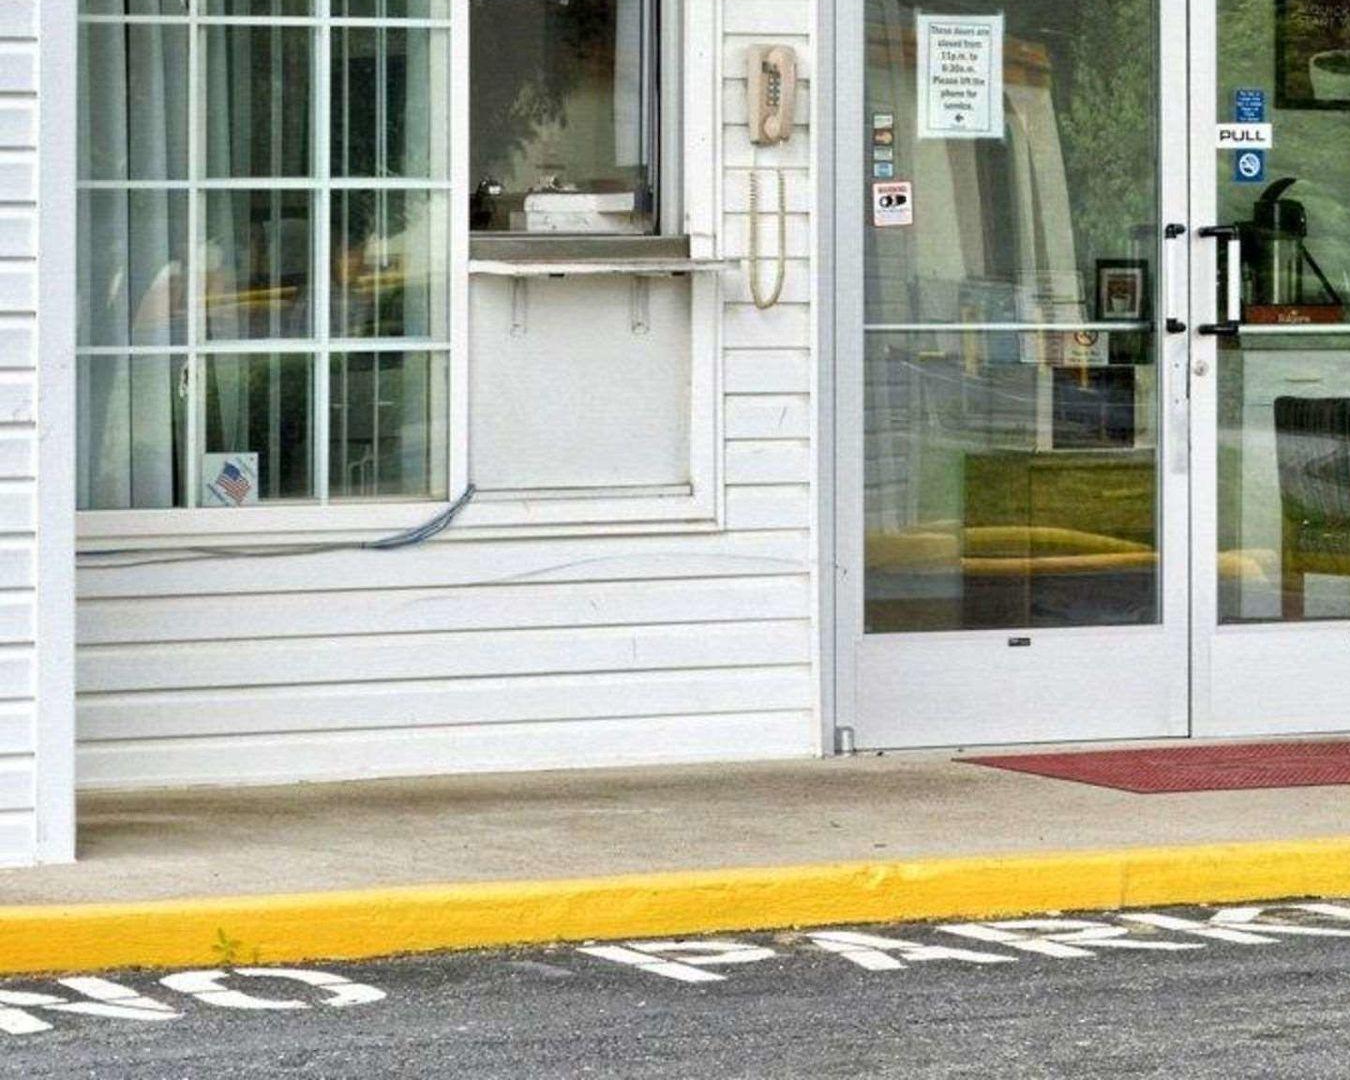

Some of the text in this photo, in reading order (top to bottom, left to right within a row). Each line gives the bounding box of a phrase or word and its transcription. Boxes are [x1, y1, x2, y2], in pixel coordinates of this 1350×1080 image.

[954, 27, 974, 36] doors
[1219, 129, 1266, 141] PULL
[0, 967, 388, 1036] NO
